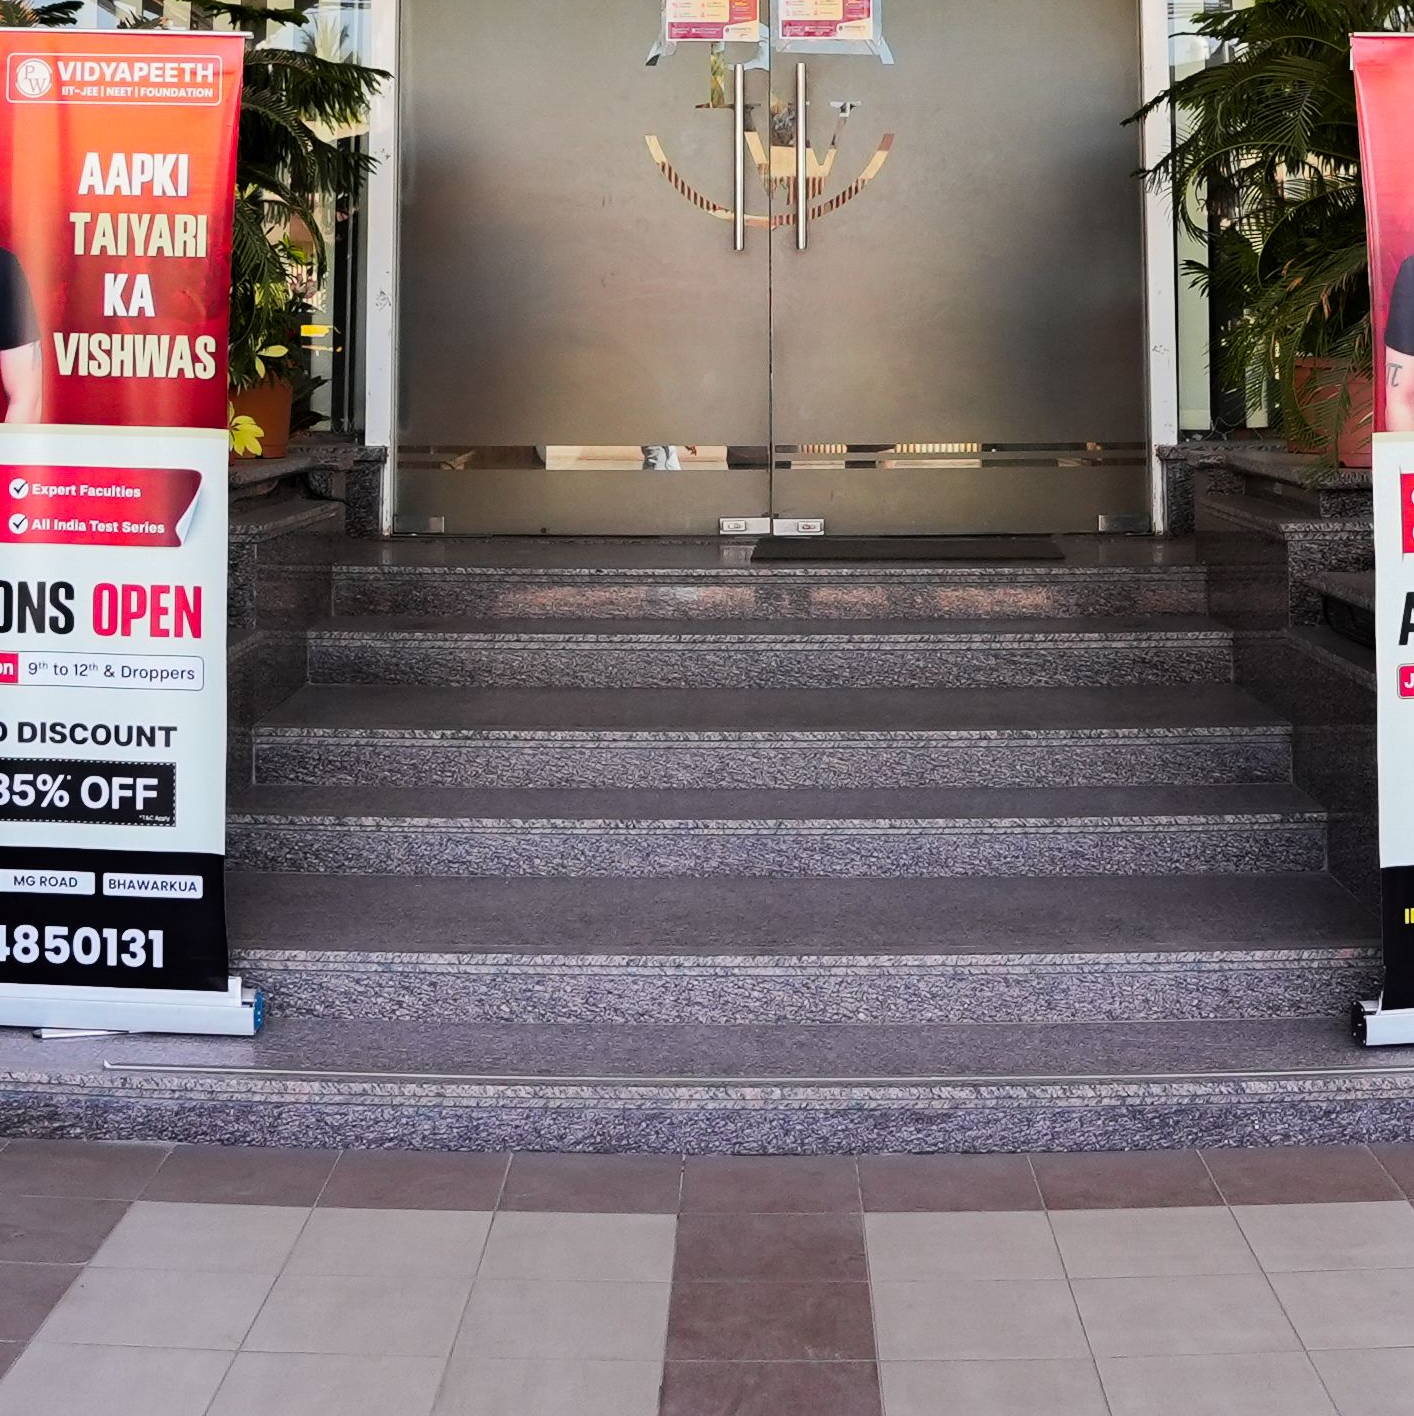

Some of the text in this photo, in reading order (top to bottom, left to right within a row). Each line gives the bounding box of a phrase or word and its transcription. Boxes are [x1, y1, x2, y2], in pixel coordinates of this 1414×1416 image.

[56, 60, 214, 83] VIDYAPEETH
[62, 87, 213, 98] IIT-JEE NEET FOUNDATION
[78, 152, 189, 197] AAPKI
[69, 212, 208, 258] TAIYARI
[103, 273, 155, 317] KA
[53, 332, 216, 380] VISHWAS
[32, 484, 141, 499] Expert Faculties
[31, 519, 165, 535] All India Test Series
[92, 583, 202, 638] OPEN
[53, 663, 69, 676] to
[103, 665, 115, 678] &
[121, 665, 195, 683] Droppers
[17, 721, 178, 748] DISCOUNT
[81, 776, 158, 810] OFF
[13, 875, 78, 888] MG ROAD
[108, 879, 197, 893] BHAWARKUA
